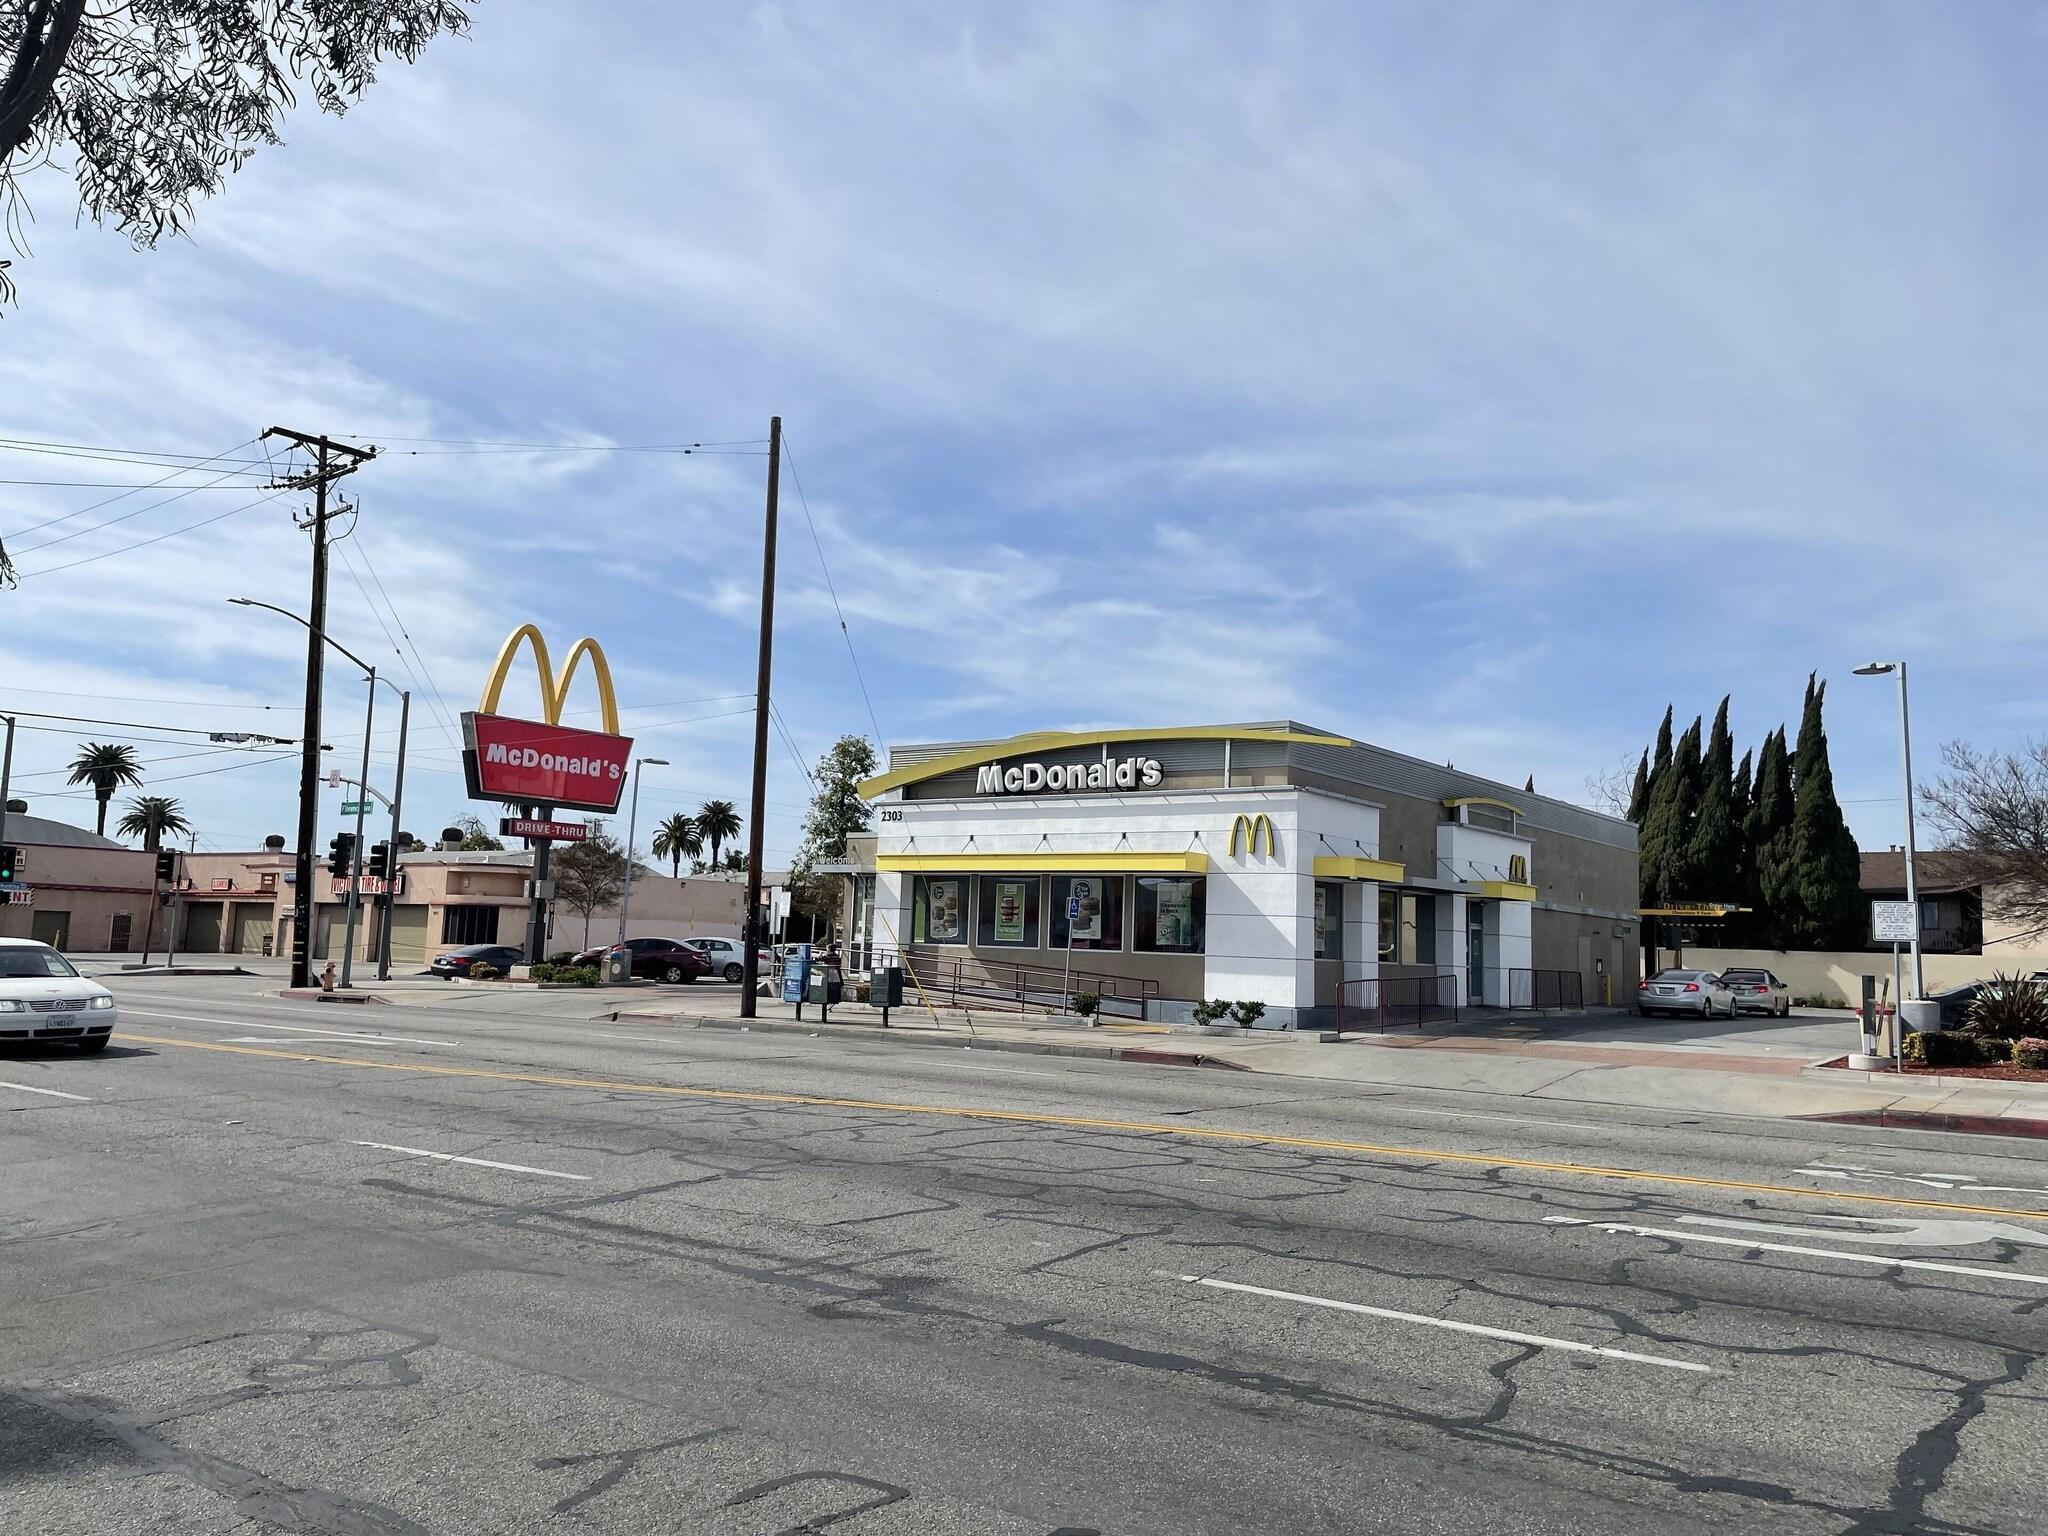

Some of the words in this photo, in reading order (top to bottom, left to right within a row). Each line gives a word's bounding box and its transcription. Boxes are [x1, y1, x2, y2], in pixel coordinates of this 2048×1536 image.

[486, 743, 620, 780] McDonald's
[975, 757, 1163, 794] McDonald's
[881, 811, 903, 822] 2303
[516, 821, 584, 837] DRIVE-THRU
[332, 877, 359, 892] VICTO
[361, 877, 375, 893] TIRE
